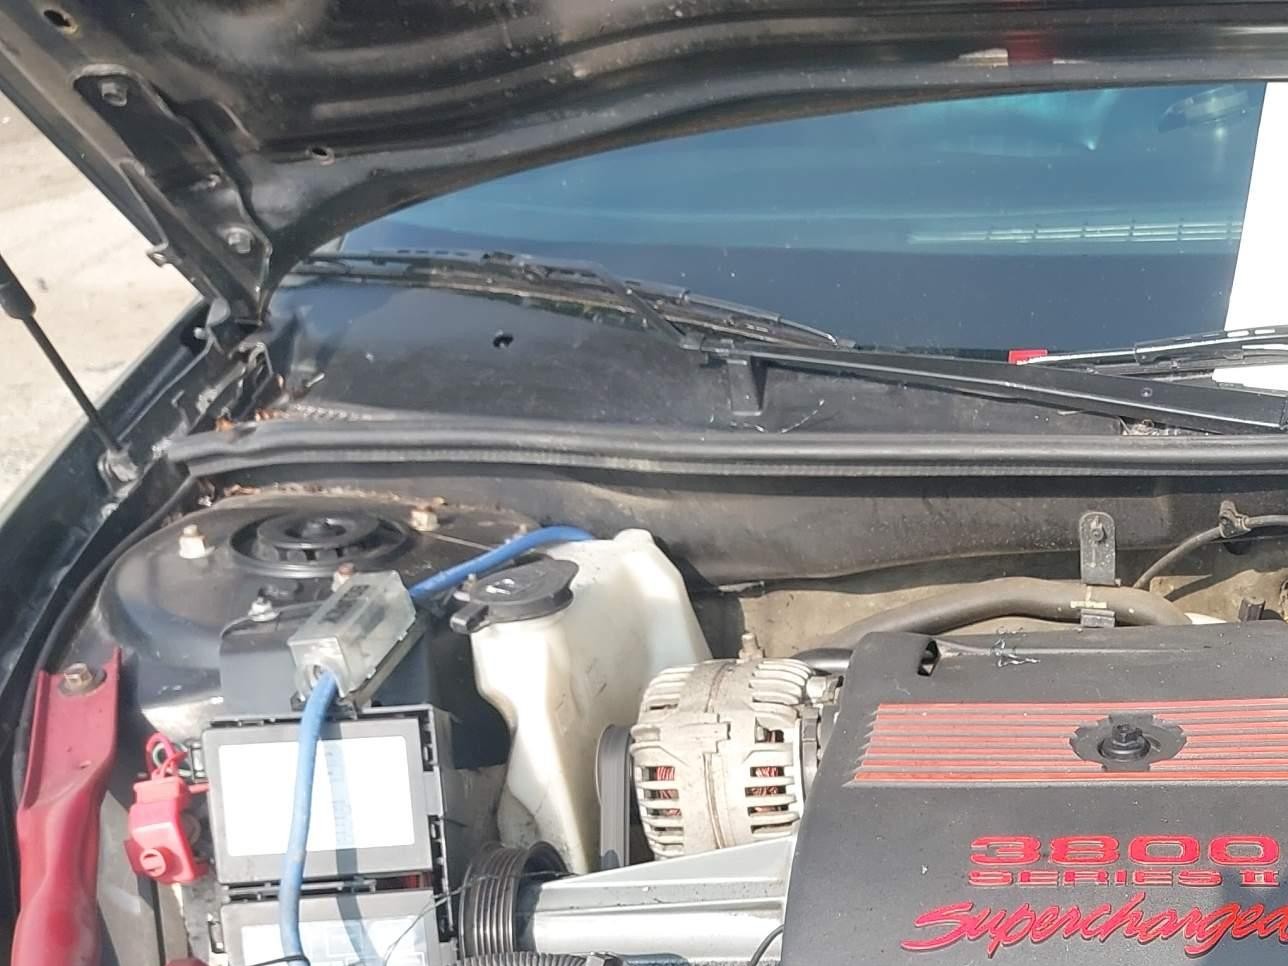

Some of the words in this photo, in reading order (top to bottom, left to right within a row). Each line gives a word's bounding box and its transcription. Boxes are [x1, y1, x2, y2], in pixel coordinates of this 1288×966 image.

[969, 834, 1281, 866] 3800
[968, 869, 1224, 888] SERIES
[1239, 869, 1280, 888] II
